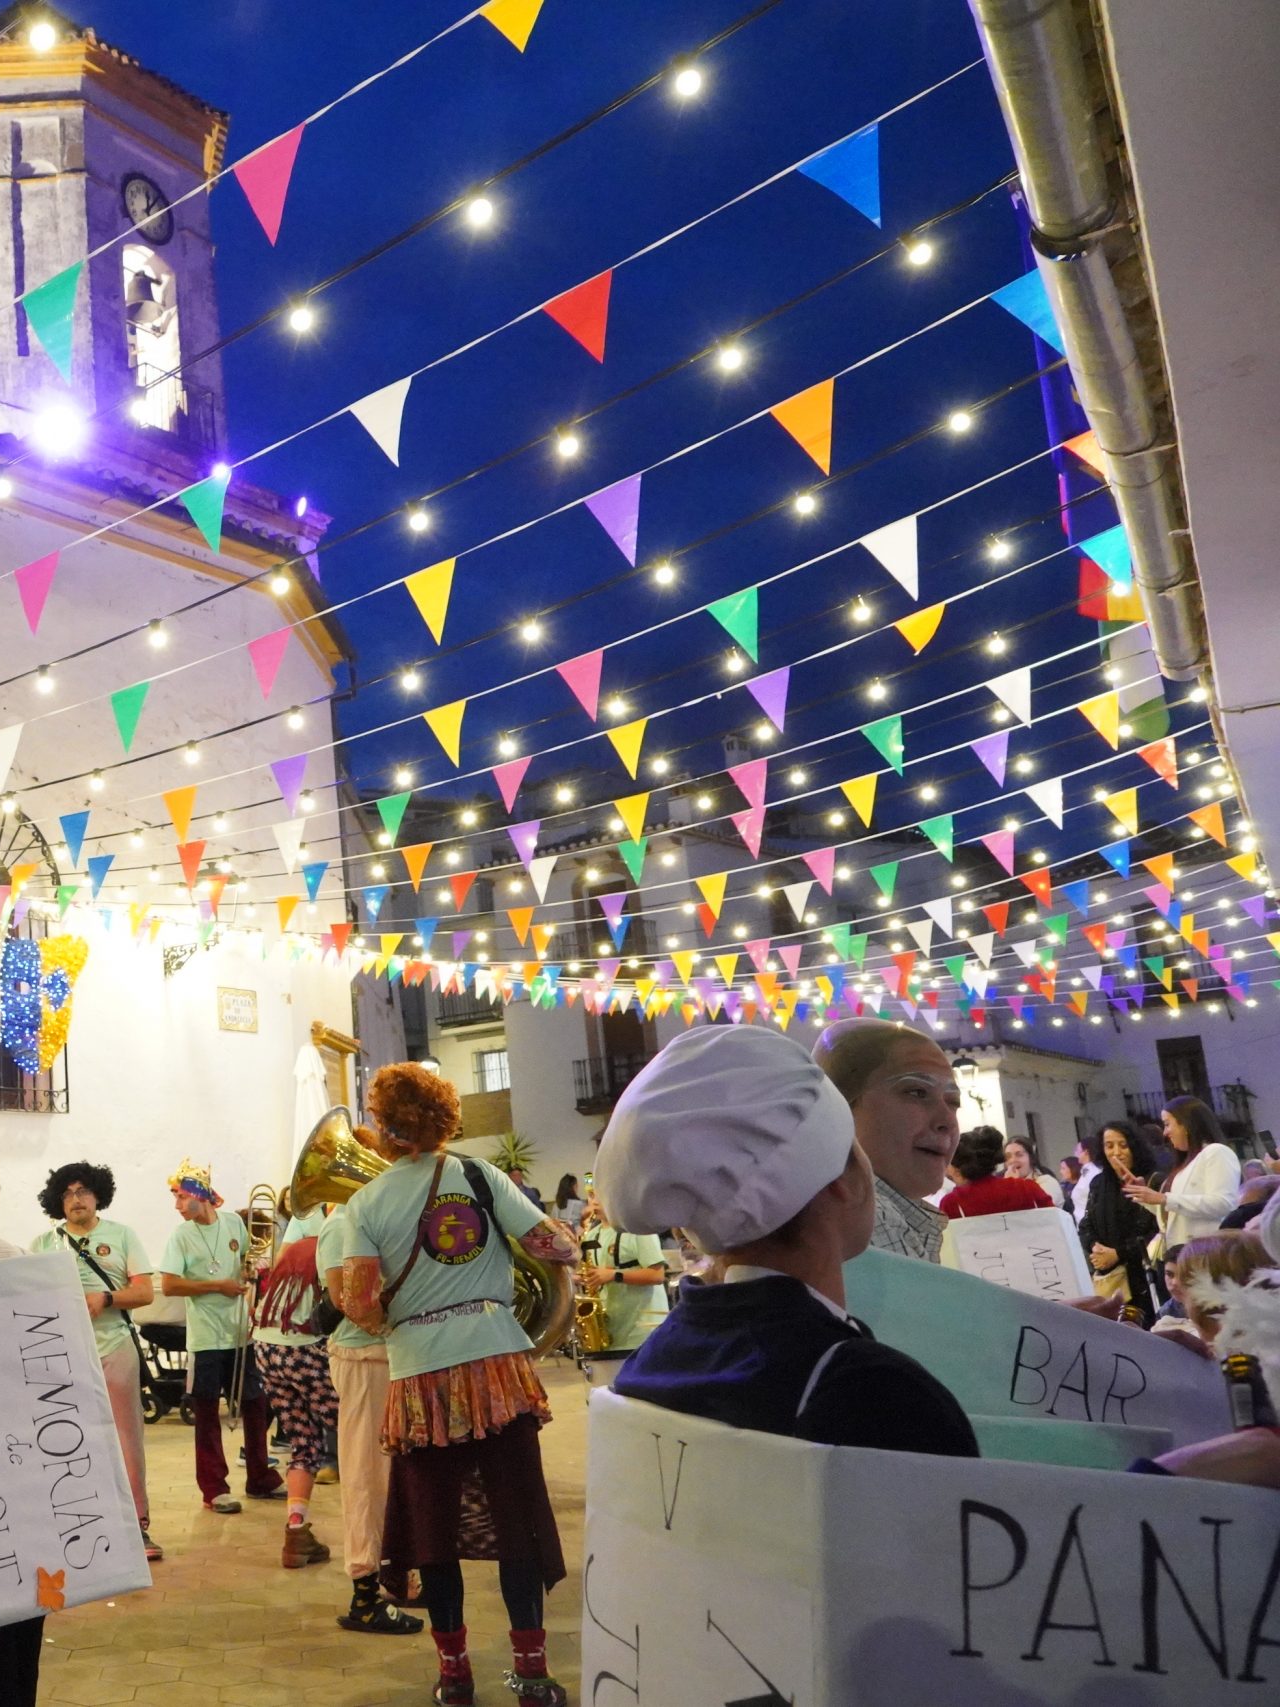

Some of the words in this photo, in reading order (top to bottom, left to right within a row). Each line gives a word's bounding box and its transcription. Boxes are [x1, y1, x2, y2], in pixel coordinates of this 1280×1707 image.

[1010, 1325, 1147, 1424] BAR
[5, 1434, 32, 1465] de
[12, 1309, 110, 1570] MEMORIAS
[651, 1432, 688, 1530] V
